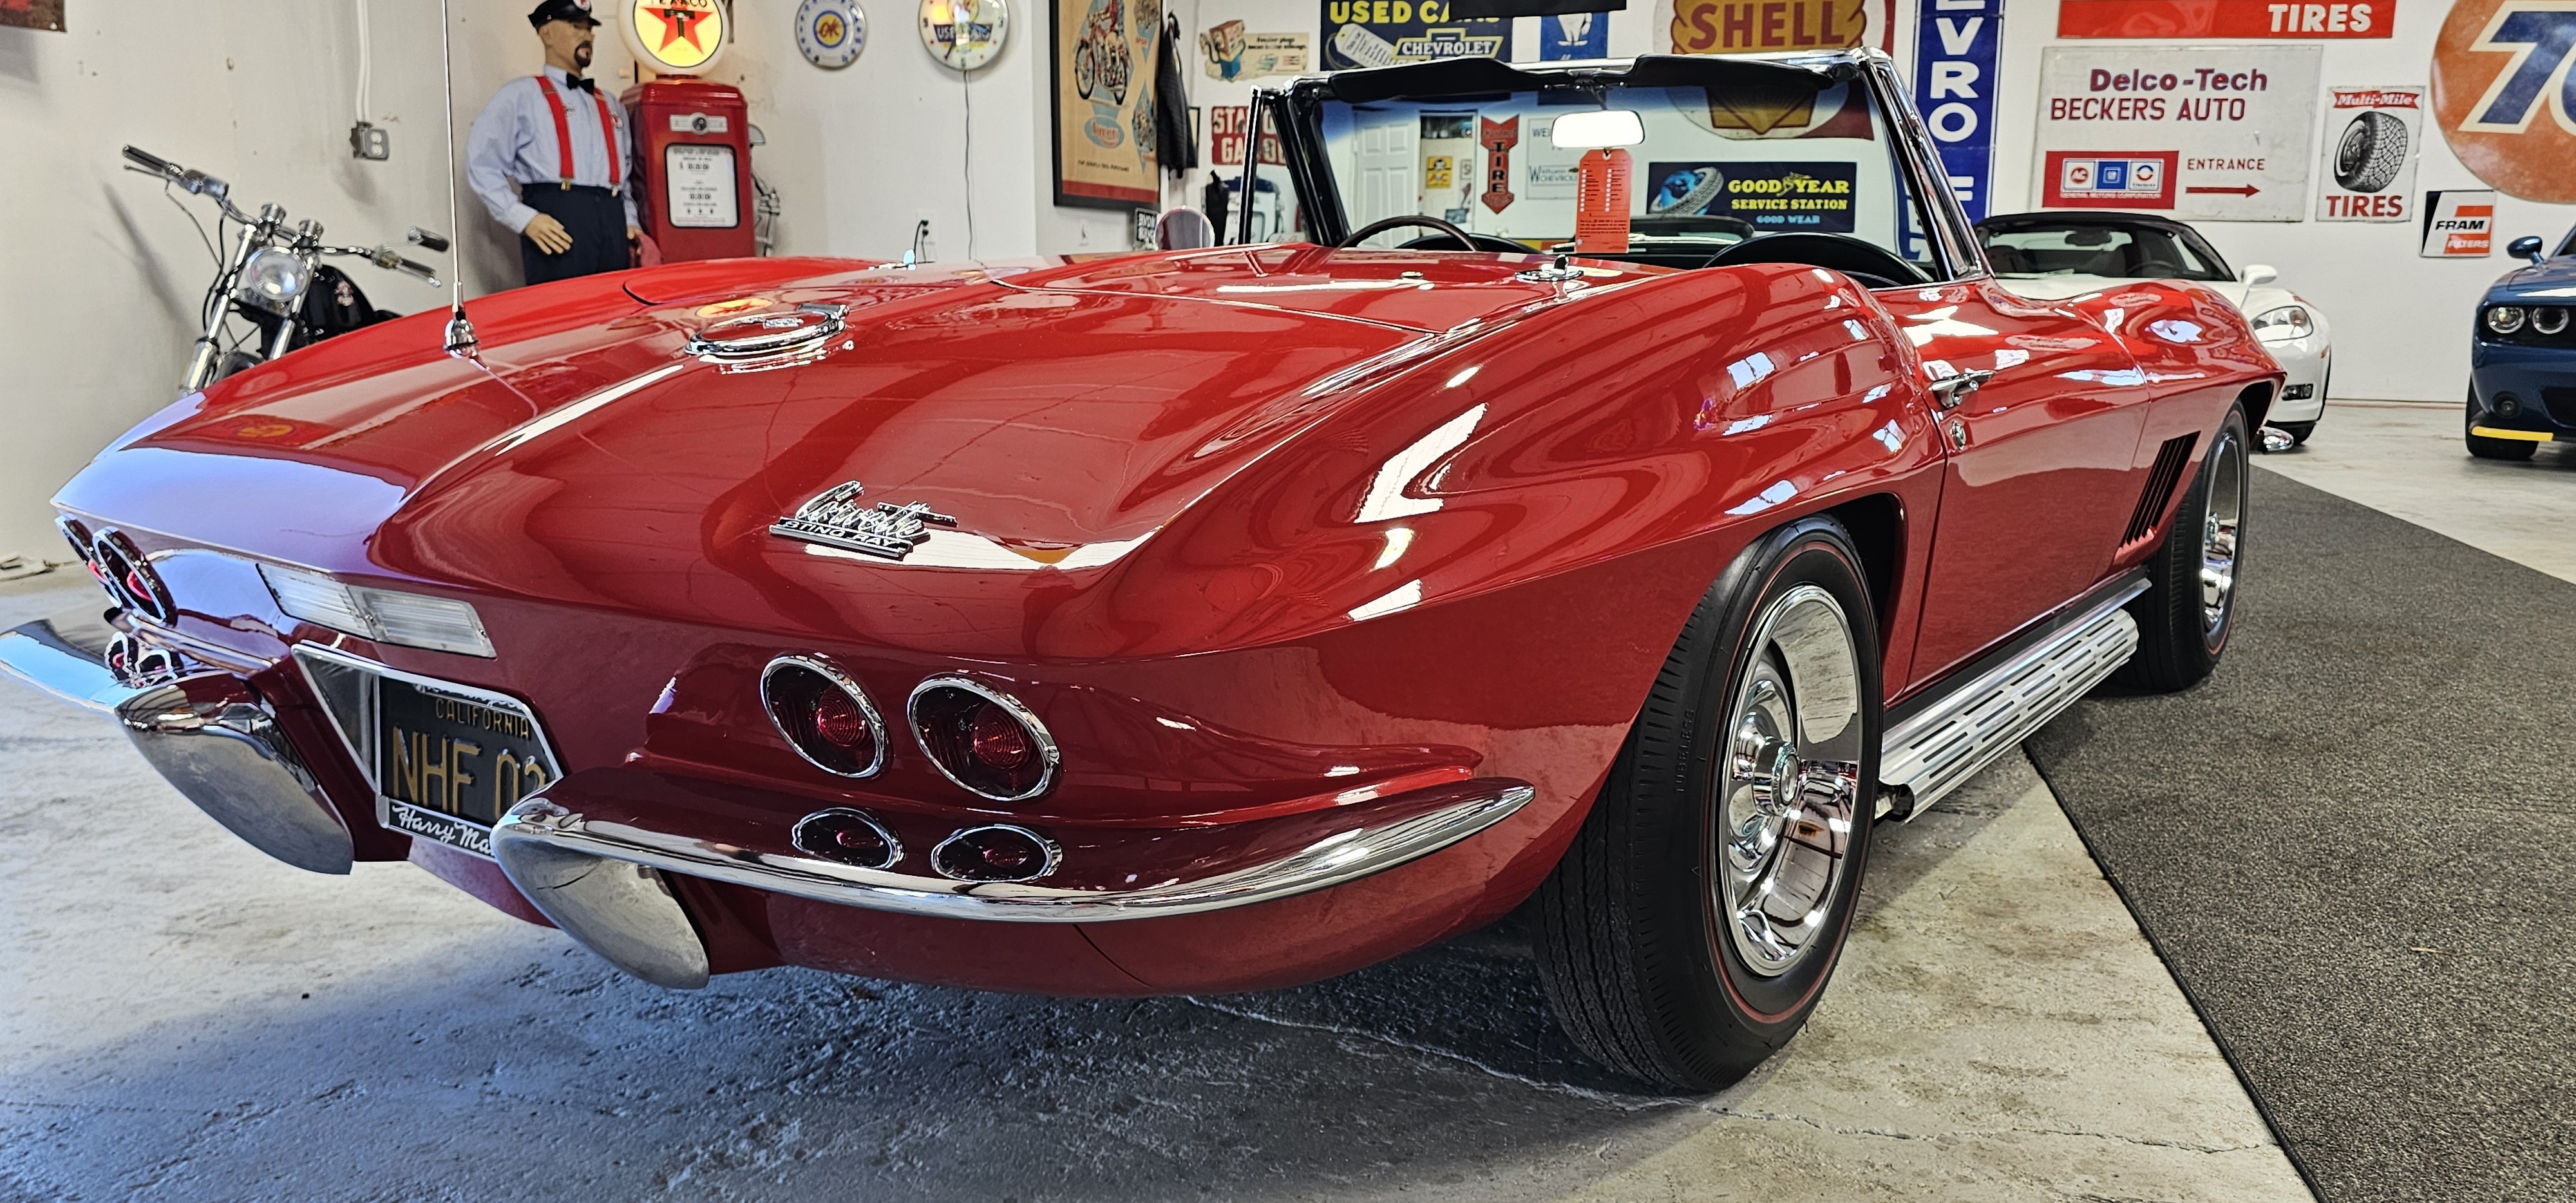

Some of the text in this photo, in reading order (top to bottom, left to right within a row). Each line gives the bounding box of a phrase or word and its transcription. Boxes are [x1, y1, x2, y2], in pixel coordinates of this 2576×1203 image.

[1329, 1, 1412, 24] USED
[2268, 4, 2372, 32] TIRES
[1688, 1, 1844, 50] SHELL
[1402, 41, 1493, 55] CHEVROLET
[2459, 1, 2576, 134] 7
[2050, 98, 2246, 121] BECKERS AUTO
[2337, 93, 2412, 106] Multi-Mile
[1486, 141, 1508, 193] TIRE
[2187, 158, 2266, 171] ENTRANCE
[1731, 199, 1848, 210] SERVICE STATION
[2325, 195, 2403, 217] TIRES
[1756, 214, 1821, 224] GOOD WEAR
[2435, 220, 2485, 230] FRAM
[784, 520, 898, 547] STING RAY
[435, 697, 529, 739] CALIFORNIA
[1674, 709, 1694, 792] TUBELESS
[392, 725, 482, 819] NHF
[392, 804, 456, 845] Harry
